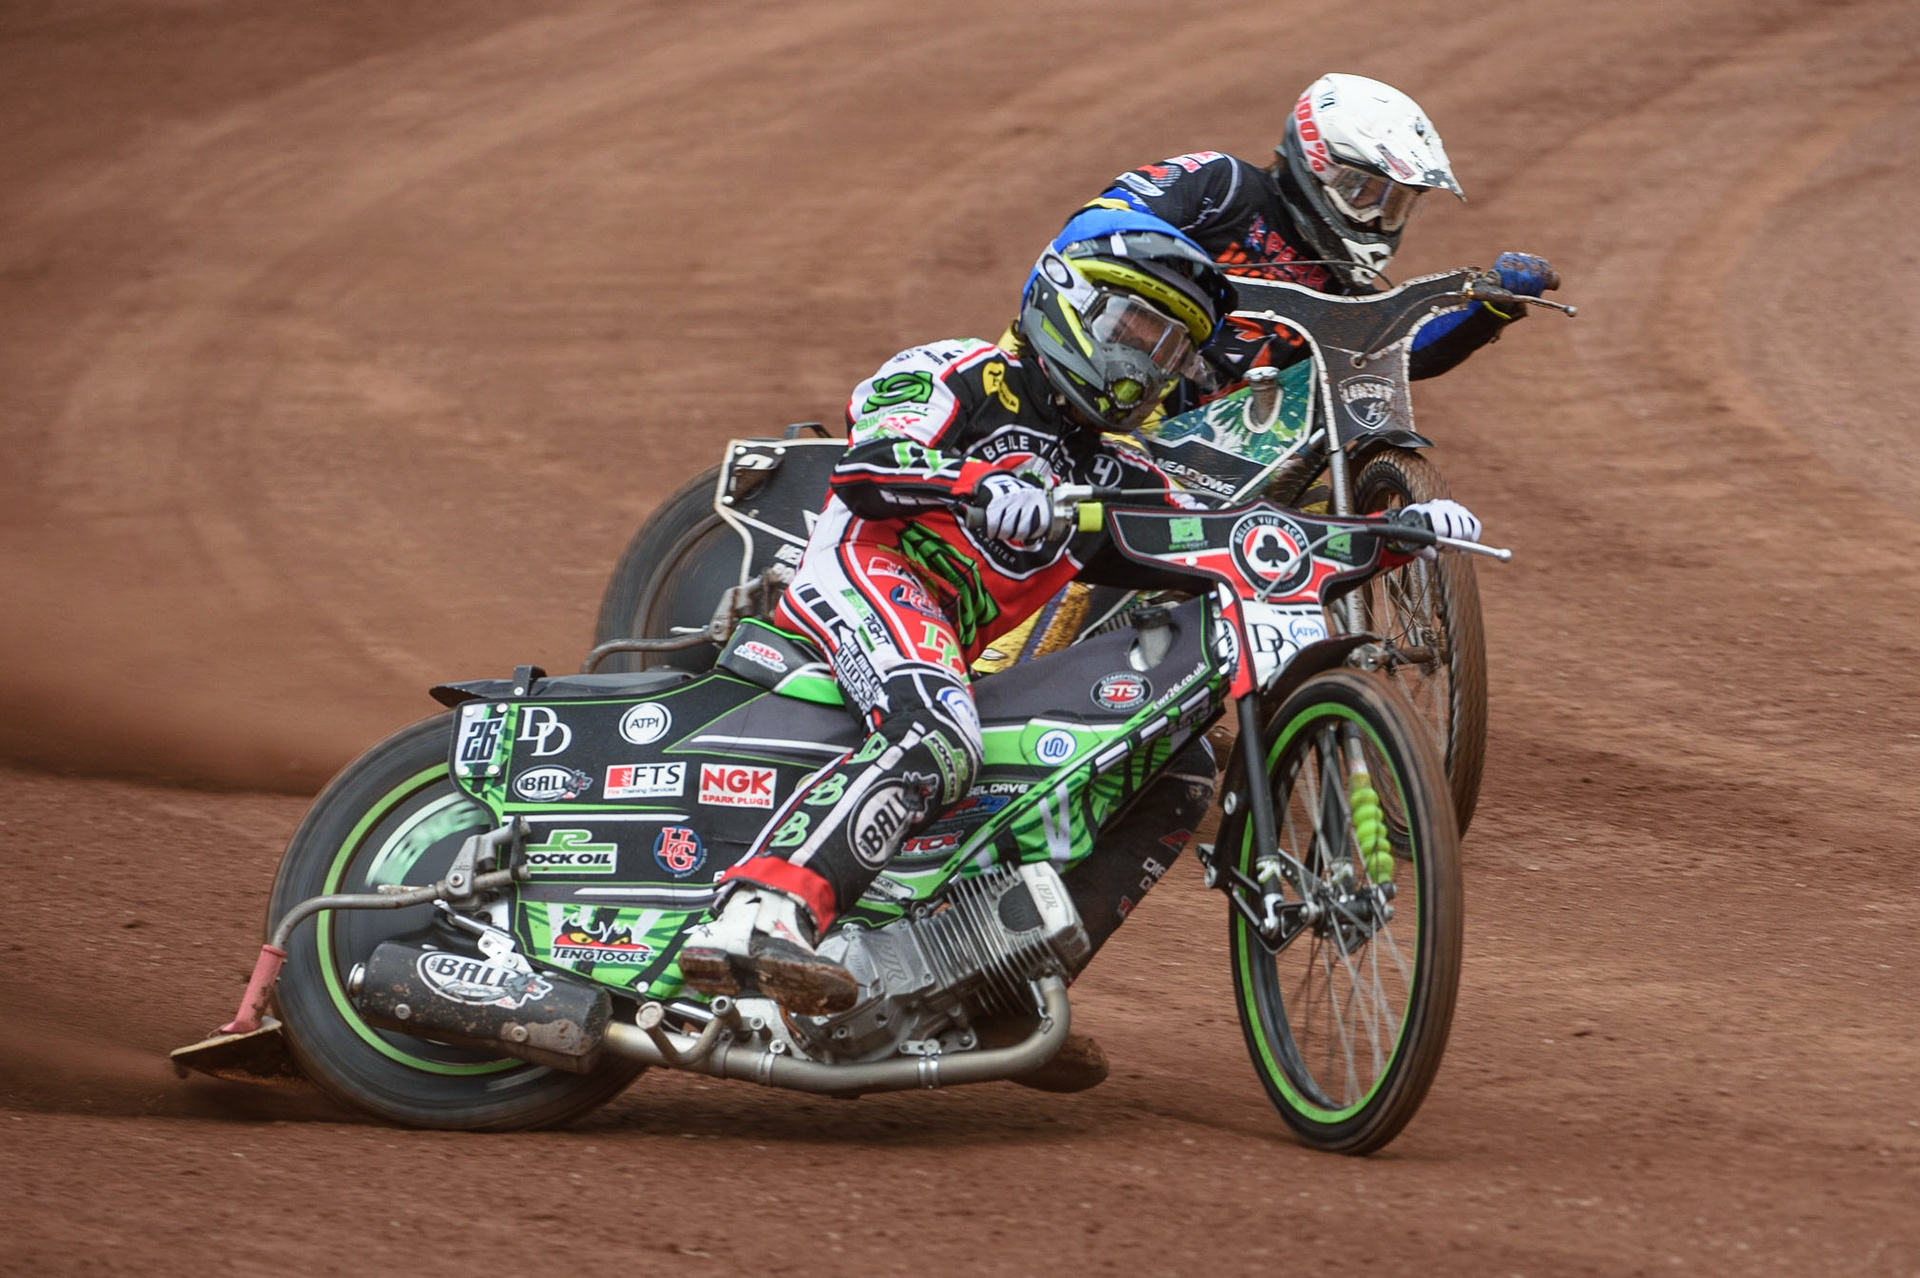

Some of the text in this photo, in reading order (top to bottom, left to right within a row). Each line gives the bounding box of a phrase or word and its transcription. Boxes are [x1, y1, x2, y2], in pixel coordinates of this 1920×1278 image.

[1092, 457, 1114, 486] 4
[1234, 516, 1306, 548] BELLE VUE ACES
[1102, 684, 1140, 698] STS
[629, 717, 660, 730] ATPI
[461, 720, 502, 762] 26
[633, 764, 681, 787] FTS
[701, 767, 774, 796] NGK
[990, 783, 1030, 794] DAVE
[702, 794, 771, 807] SPARK PLUGS
[577, 853, 612, 865] OIL
